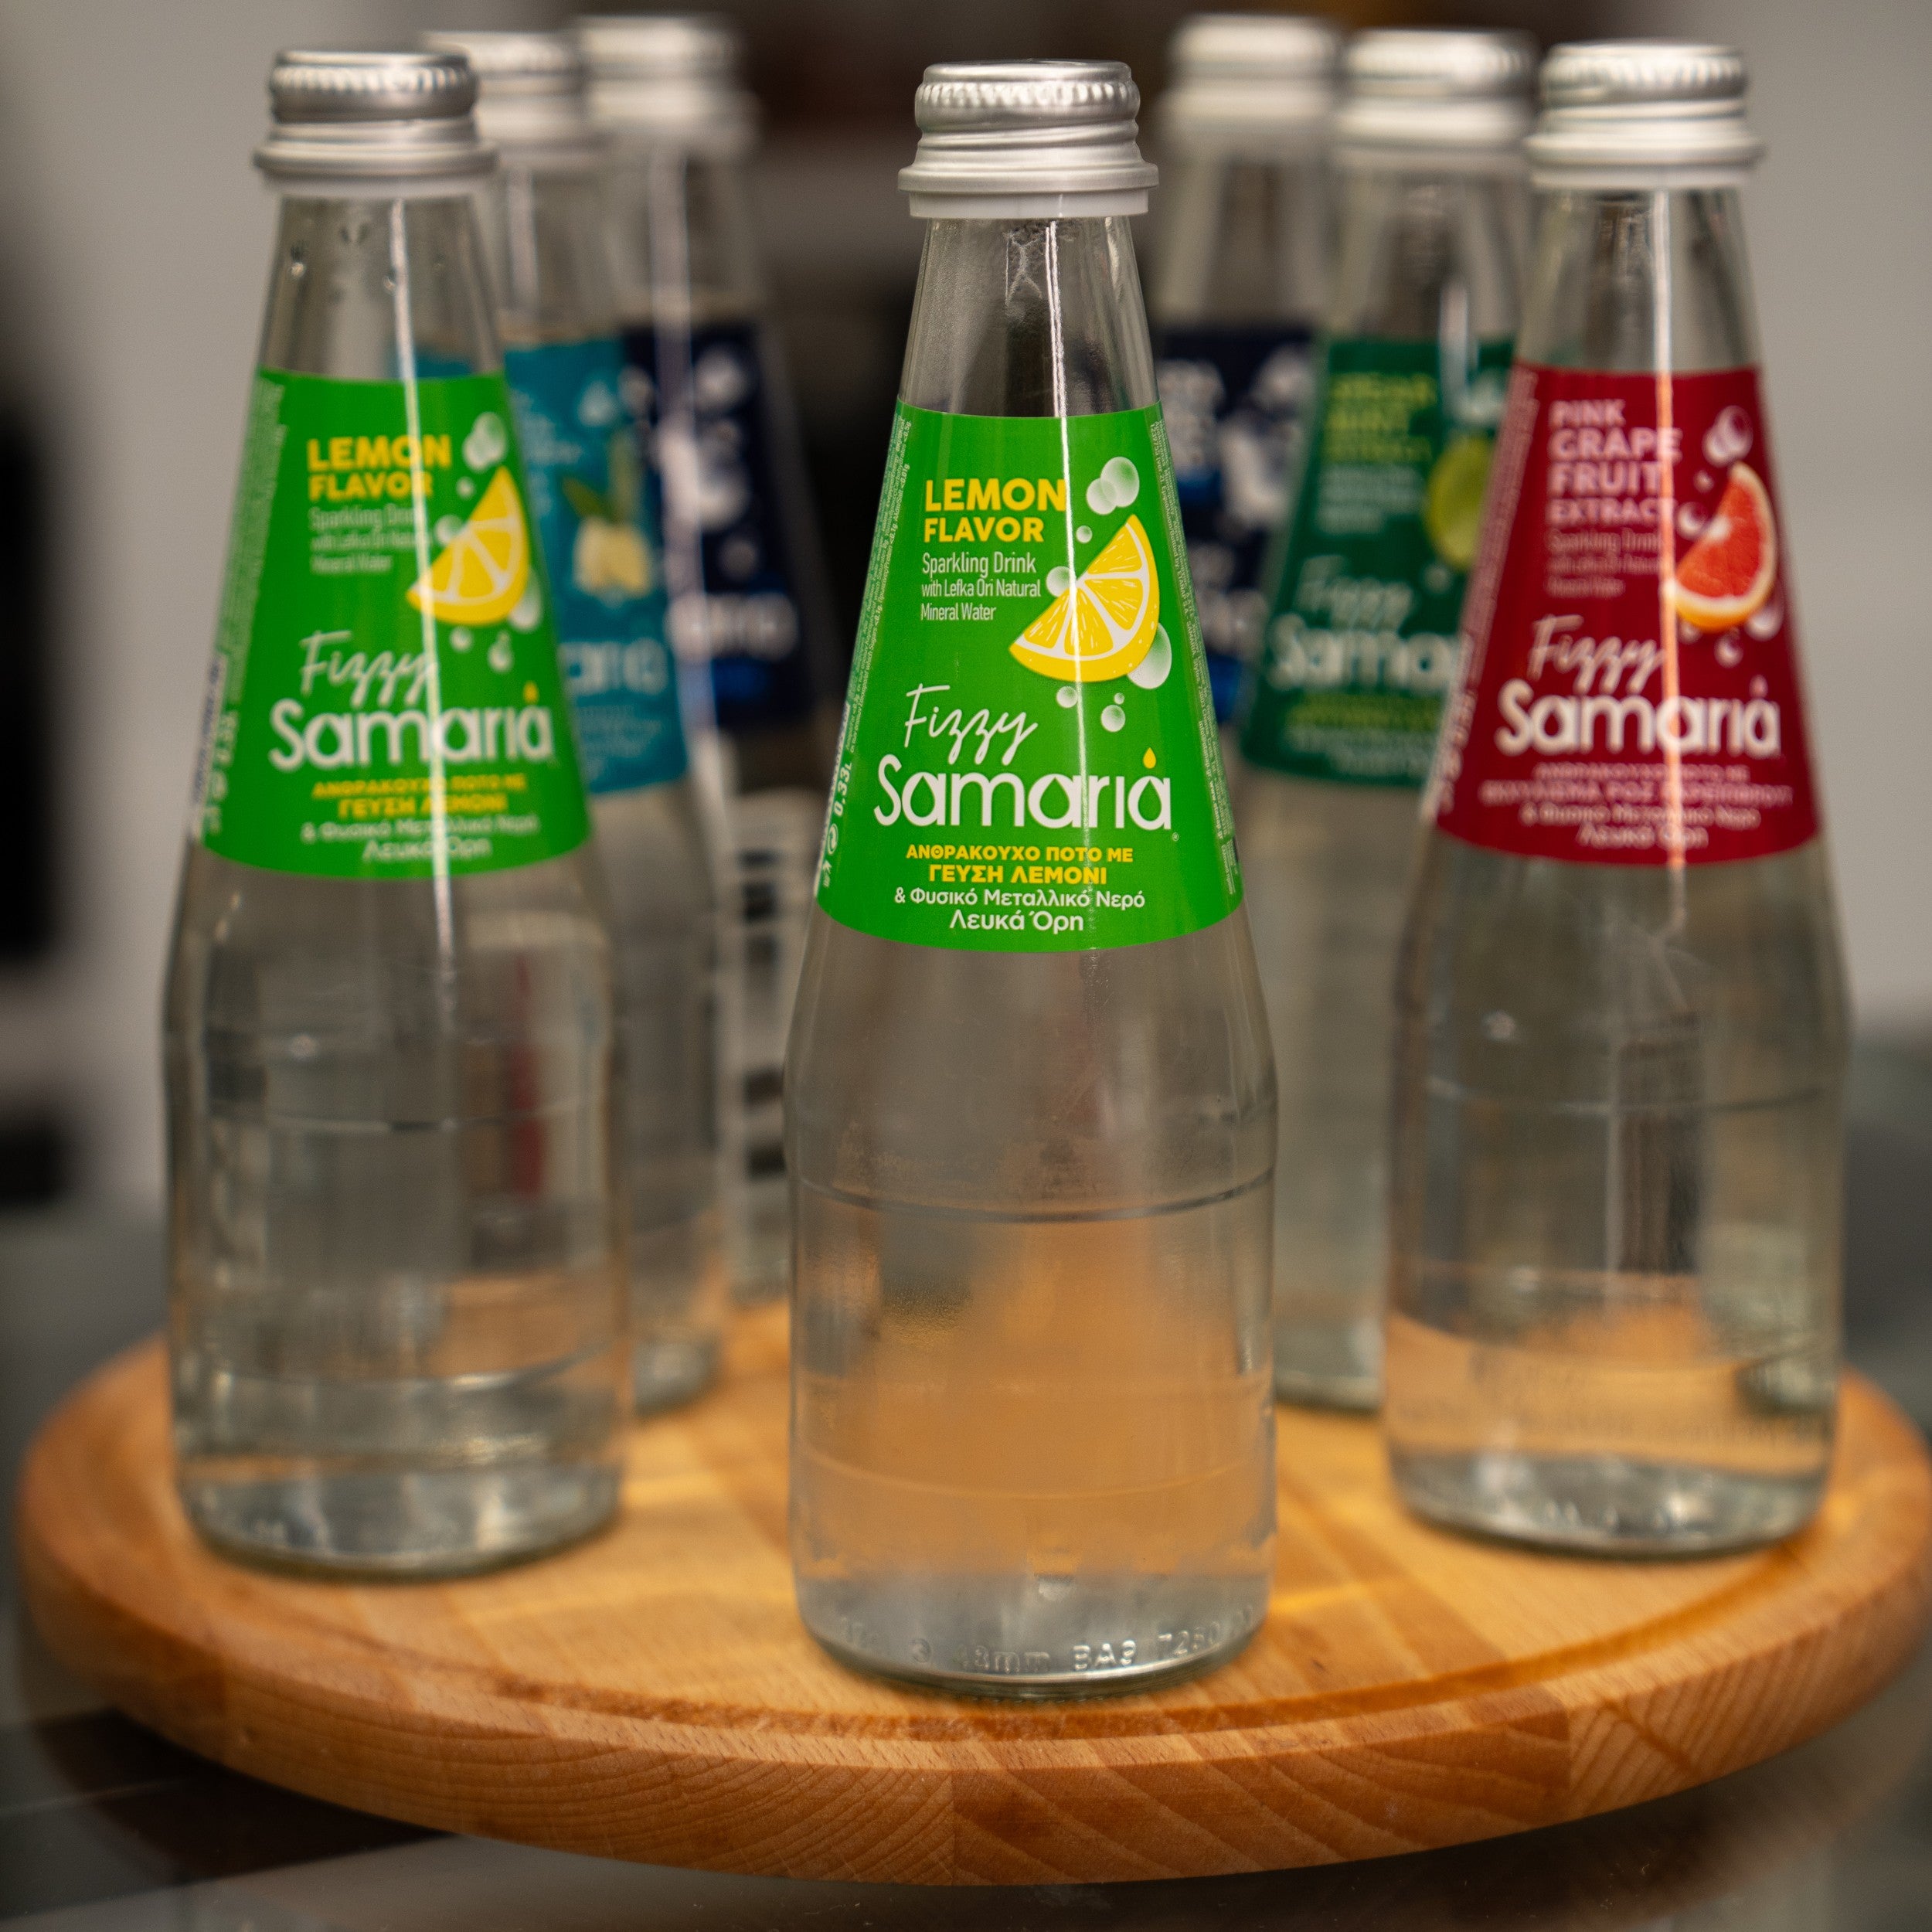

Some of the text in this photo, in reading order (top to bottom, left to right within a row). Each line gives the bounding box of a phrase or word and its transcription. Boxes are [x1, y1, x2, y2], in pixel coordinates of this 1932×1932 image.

[1549, 398, 1626, 427] PINK
[308, 434, 451, 472] LEMON
[1548, 427, 1682, 462] GRAPE
[926, 478, 1066, 512] LEMON
[924, 516, 1044, 543] FLAVOR
[923, 551, 1036, 579] Sparkling Drink
[922, 577, 1041, 597] with Lefka Ori Natural
[921, 602, 996, 621] Mineral Water
[300, 630, 437, 709] Fizzy
[905, 683, 1038, 765] Fizzy
[1495, 678, 1781, 757] Samaria
[268, 698, 556, 771] Samaria
[873, 753, 1172, 832] Samaria
[906, 845, 1133, 862] ΑΝΘΡΑΚΟΥΧΟ ΠΟΤΟ ΜΕ
[929, 865, 1107, 885] ΓΕΥΣΗ ΛΕΜΟΝΙ
[894, 886, 1145, 911] & Φυσικό Μεταλλικό Νερό
[949, 910, 1083, 935] Λευκά Όρη
